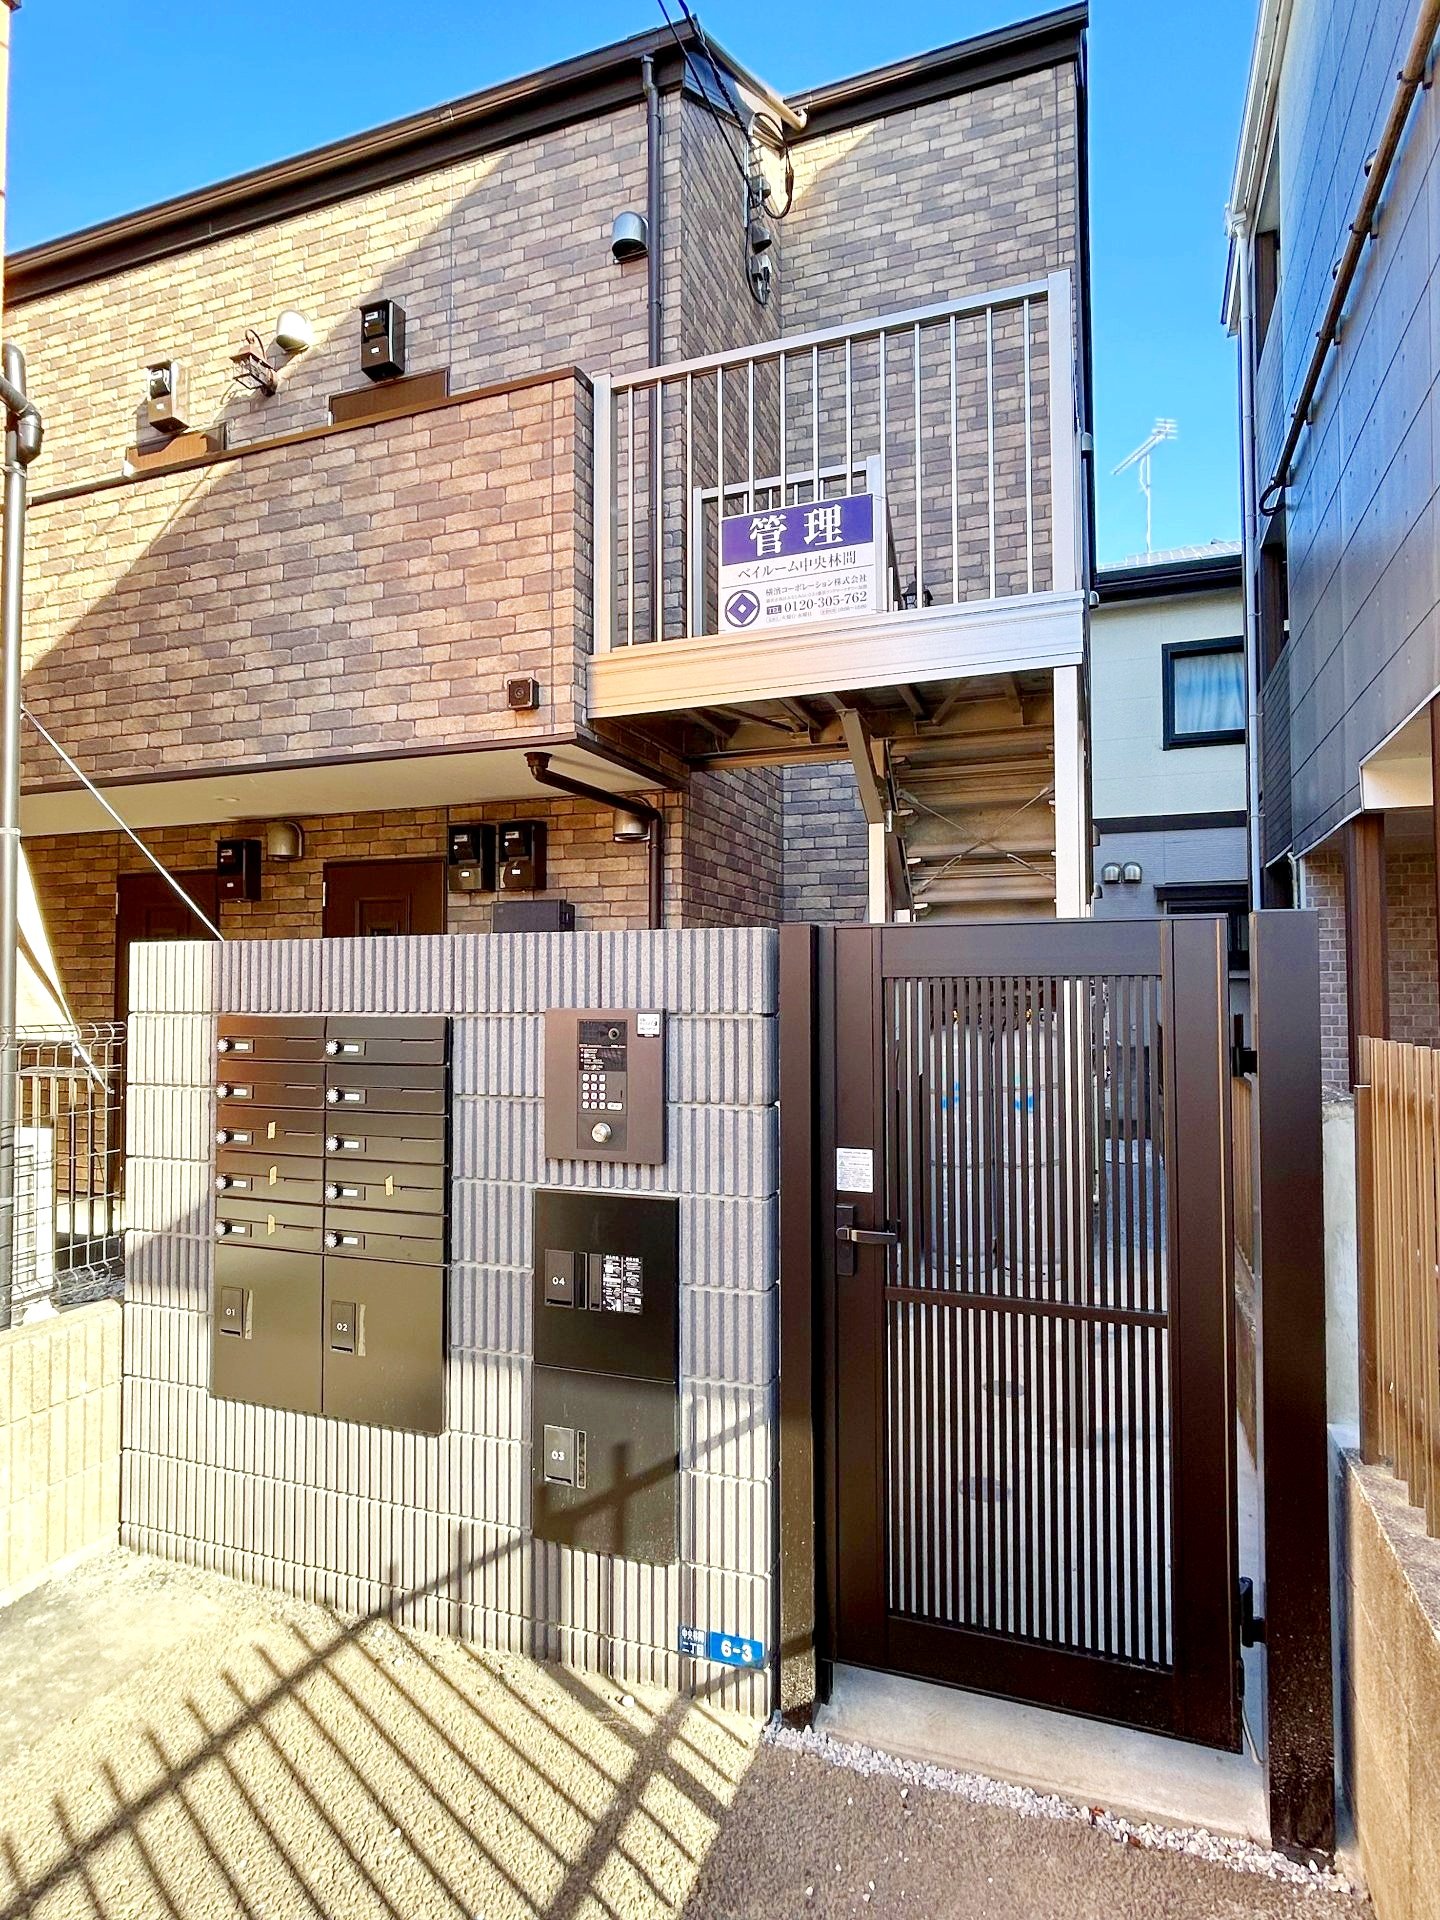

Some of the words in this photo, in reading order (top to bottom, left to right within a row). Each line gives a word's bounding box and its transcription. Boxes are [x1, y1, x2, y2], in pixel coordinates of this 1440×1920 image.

[750, 503, 844, 557] 管理
[738, 550, 857, 579] ベイルーム中央林間
[784, 590, 867, 612] 0120-305-762
[552, 1276, 566, 1286] 04
[226, 1308, 235, 1317] 01
[336, 1323, 348, 1332] 02
[551, 1451, 565, 1461] 03
[721, 1640, 753, 1662] 6-3
